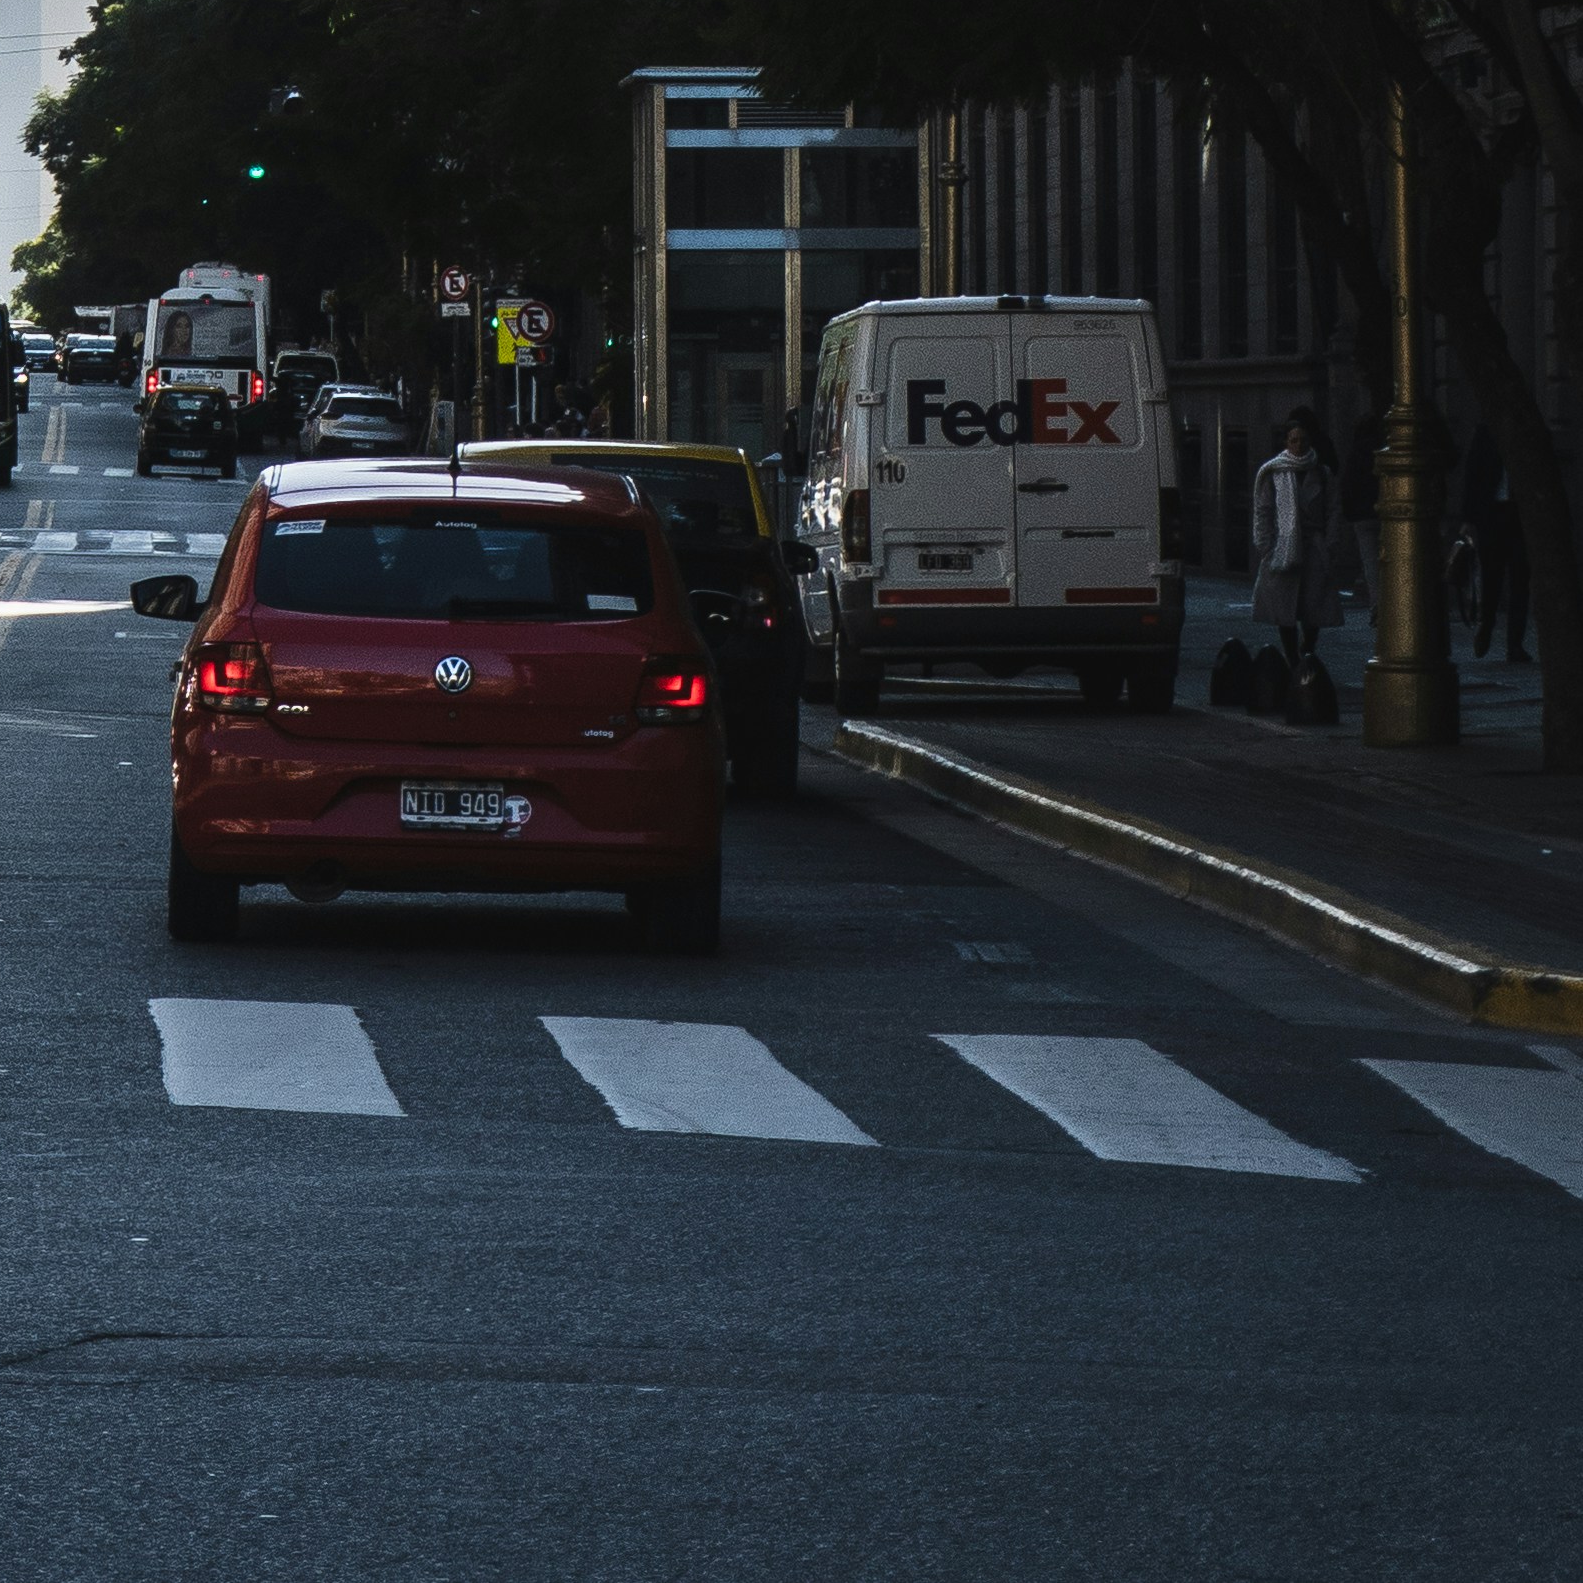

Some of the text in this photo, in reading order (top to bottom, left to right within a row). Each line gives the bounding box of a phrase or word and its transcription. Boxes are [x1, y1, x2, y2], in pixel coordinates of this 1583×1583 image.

[907, 378, 1121, 446] FedEx
[876, 459, 905, 484] 110
[277, 704, 312, 715] GOL
[406, 792, 500, 816] NID 949
